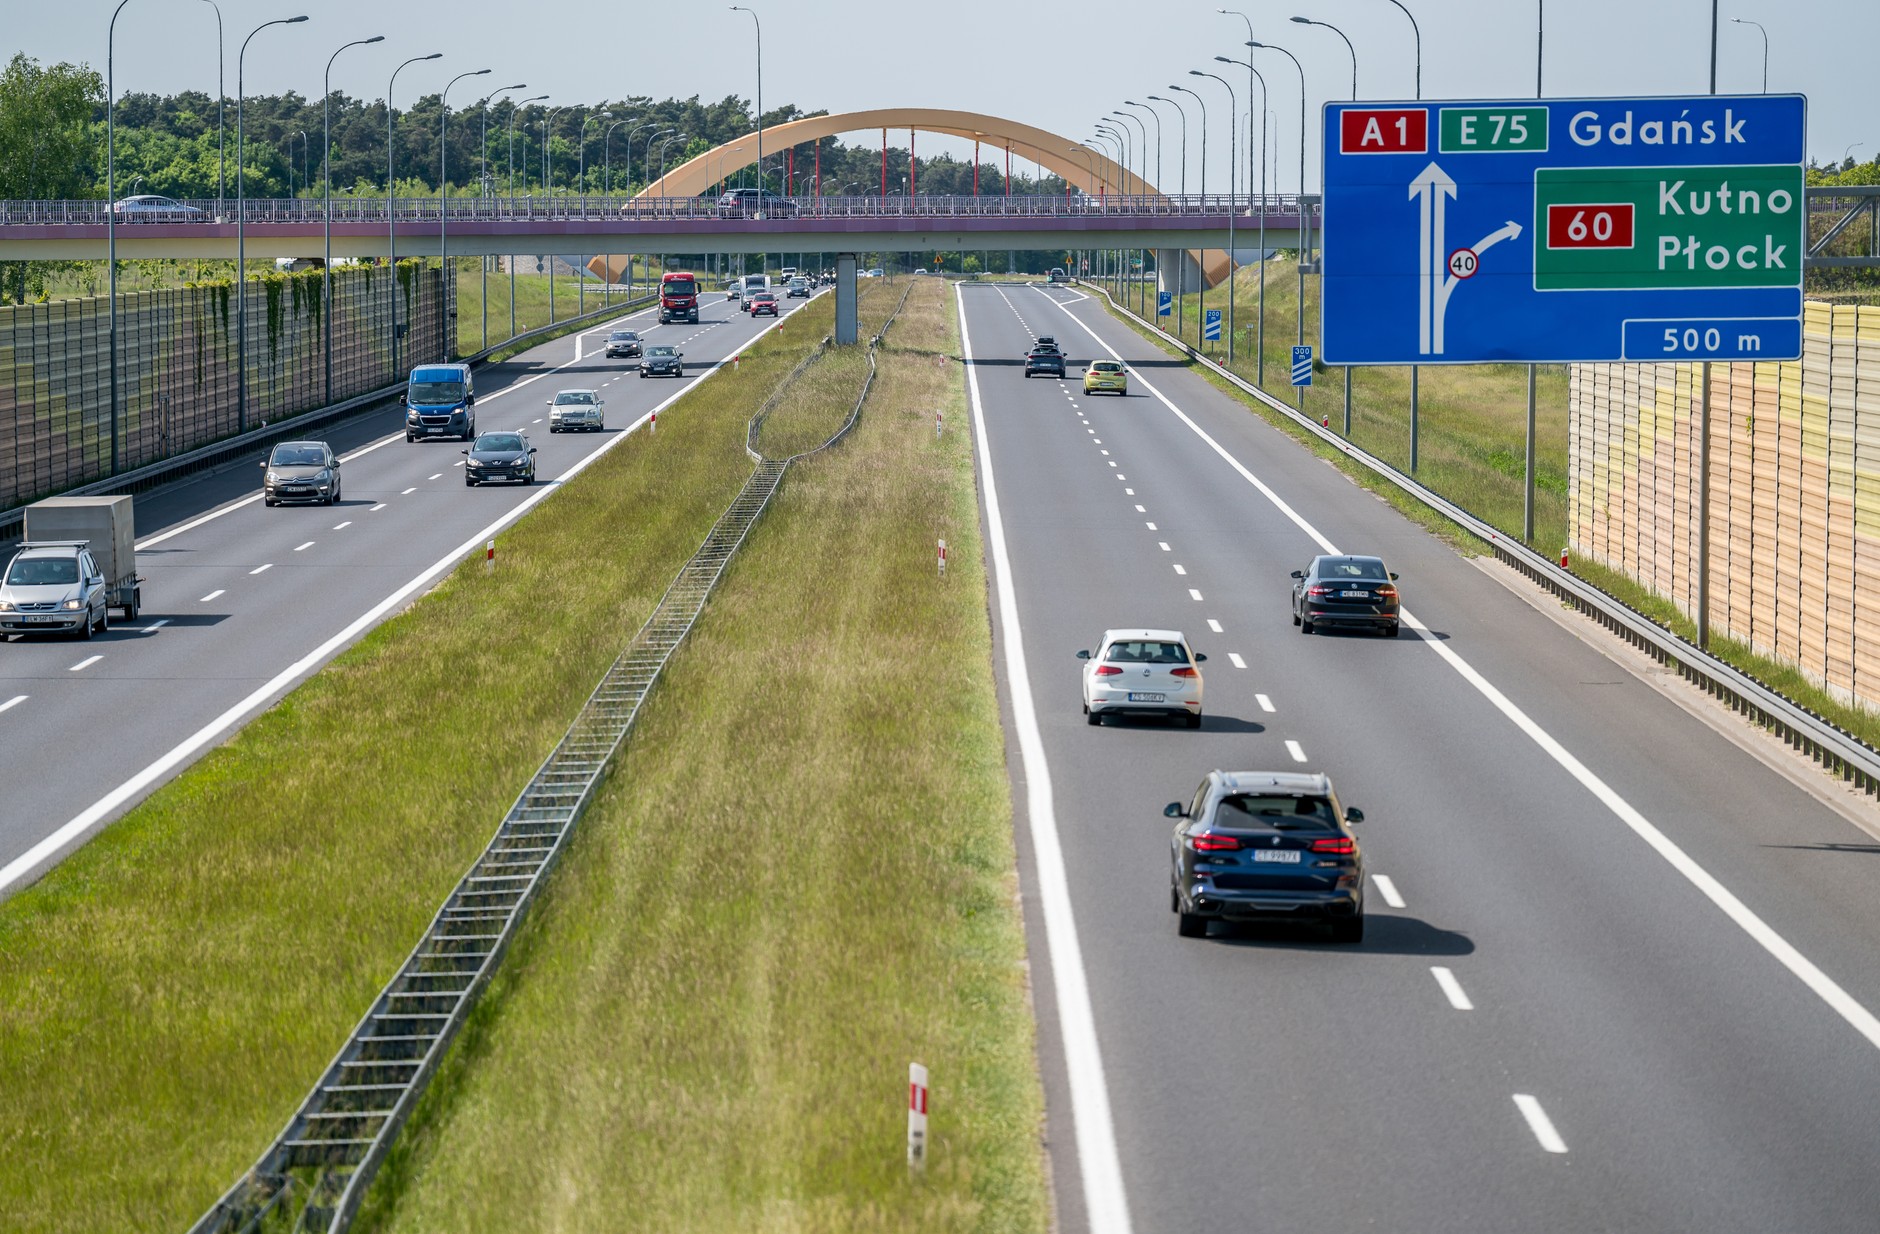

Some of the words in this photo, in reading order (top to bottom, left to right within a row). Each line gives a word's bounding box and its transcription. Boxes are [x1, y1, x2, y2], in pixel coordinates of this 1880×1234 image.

[1460, 115, 1478, 145] E
[1488, 115, 1528, 144] 75
[1569, 109, 1746, 147] Gdańsk
[1659, 180, 1793, 216] Kutno
[1567, 211, 1613, 242] 60
[1452, 256, 1475, 272] 40
[1658, 234, 1787, 270] Płock
[1294, 347, 1310, 355] 300
[1663, 328, 1721, 352] 500
[1738, 334, 1761, 351] m
